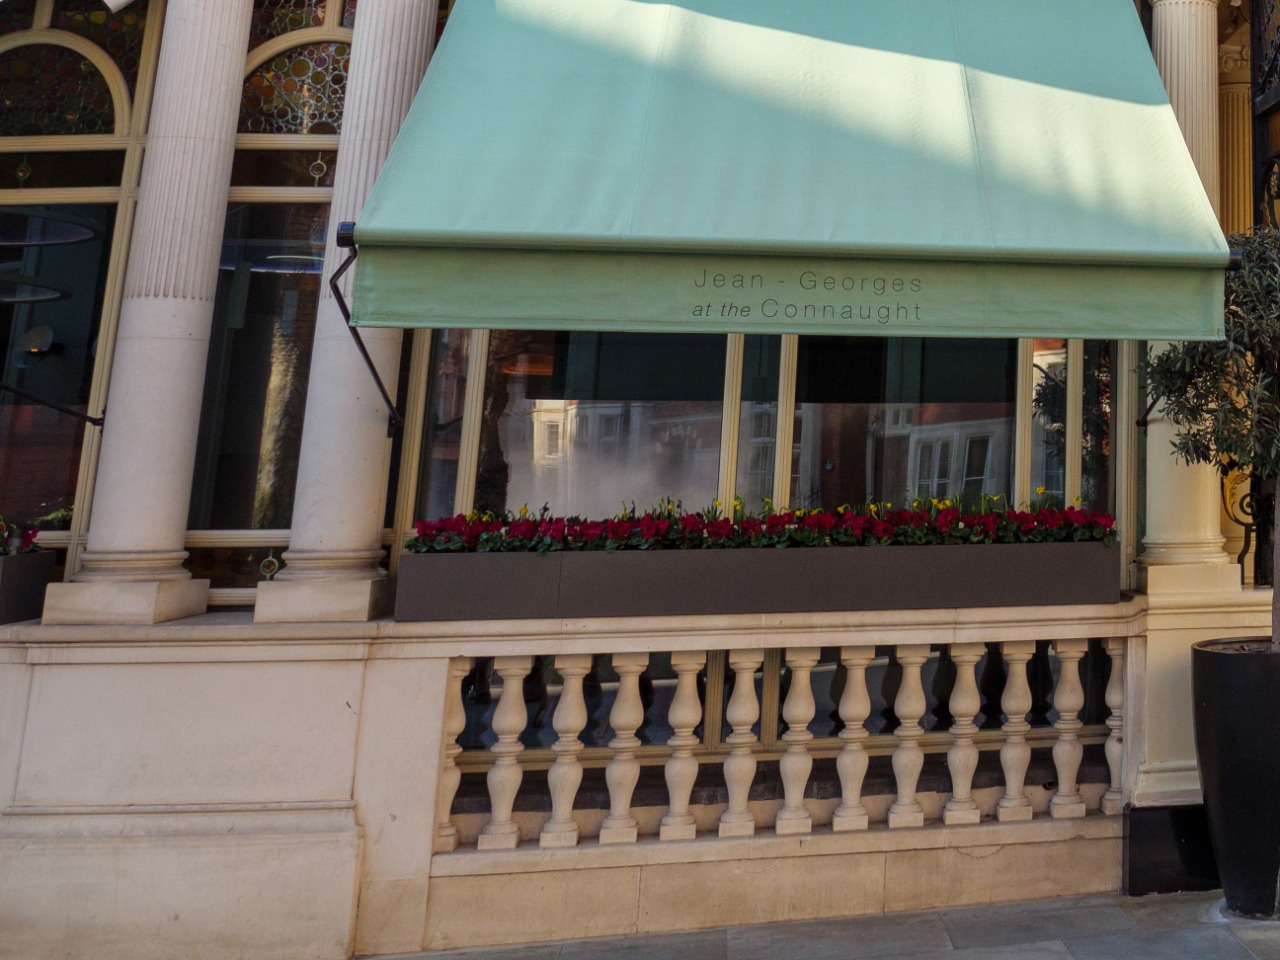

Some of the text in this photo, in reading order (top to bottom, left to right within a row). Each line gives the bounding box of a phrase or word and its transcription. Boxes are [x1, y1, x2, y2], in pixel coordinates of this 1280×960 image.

[694, 269, 764, 289] Jean
[799, 271, 922, 296] Georges
[692, 298, 921, 325] at the Connaught
